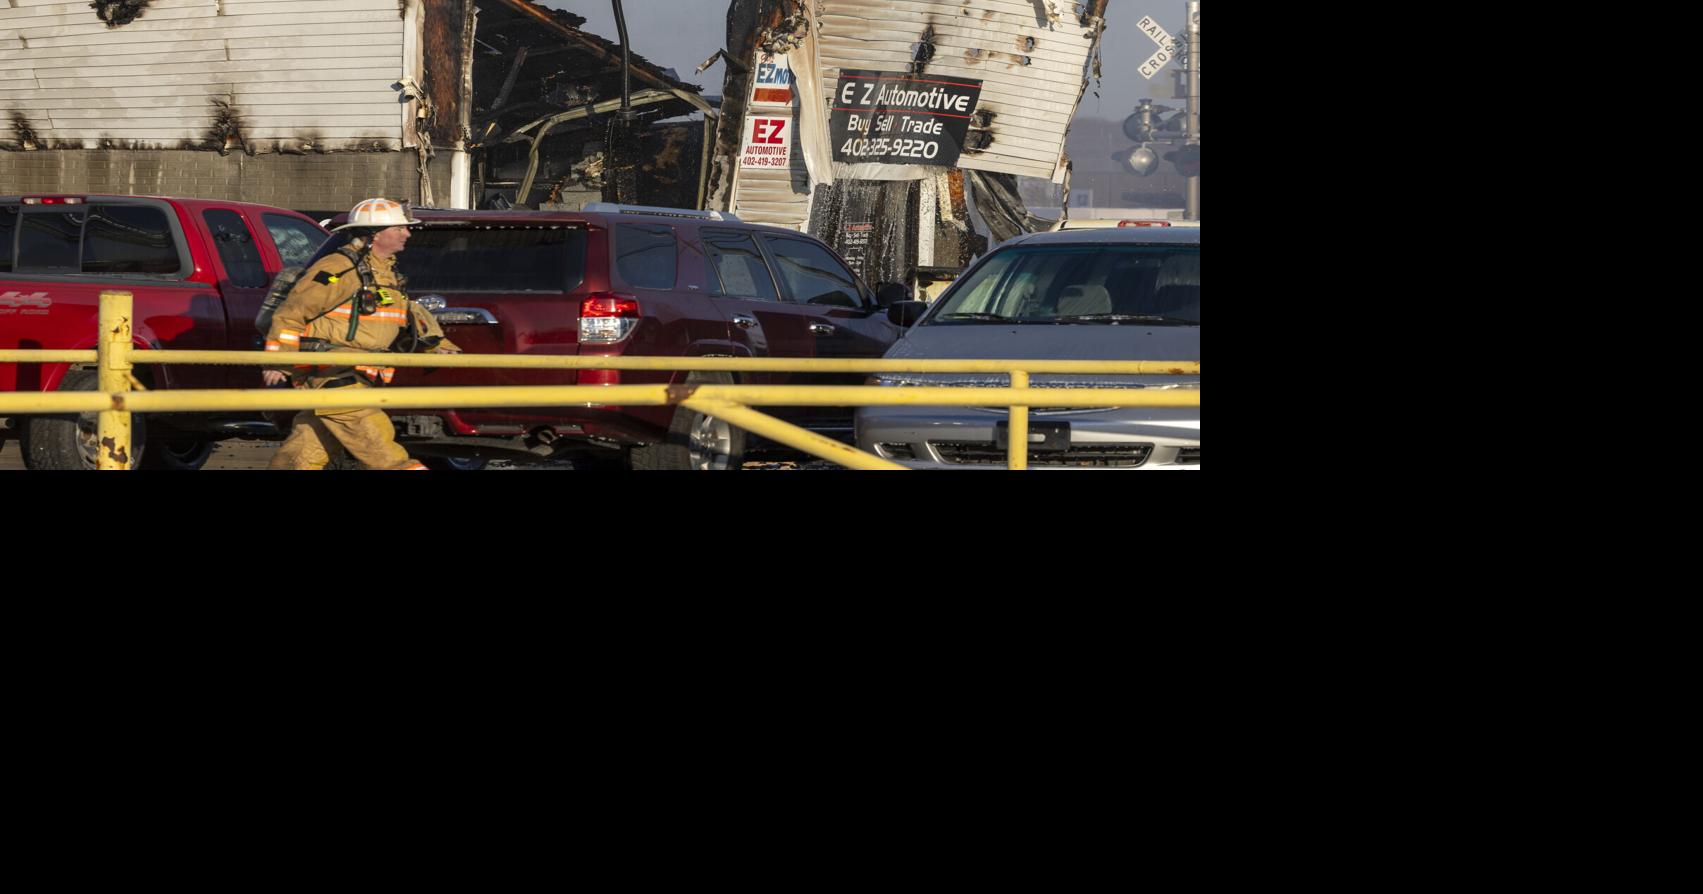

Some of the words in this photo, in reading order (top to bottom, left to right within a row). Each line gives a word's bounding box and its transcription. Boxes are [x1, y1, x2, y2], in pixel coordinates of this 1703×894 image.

[875, 84, 970, 112] Automotive
[752, 119, 785, 144] EZ
[847, 114, 871, 135] Buy
[875, 115, 894, 132] Sell
[901, 116, 943, 135] Trade
[745, 146, 787, 155] AUTOMOTIVE
[841, 138, 939, 159] 402-325-9220
[742, 157, 787, 166] 402-419-3207
